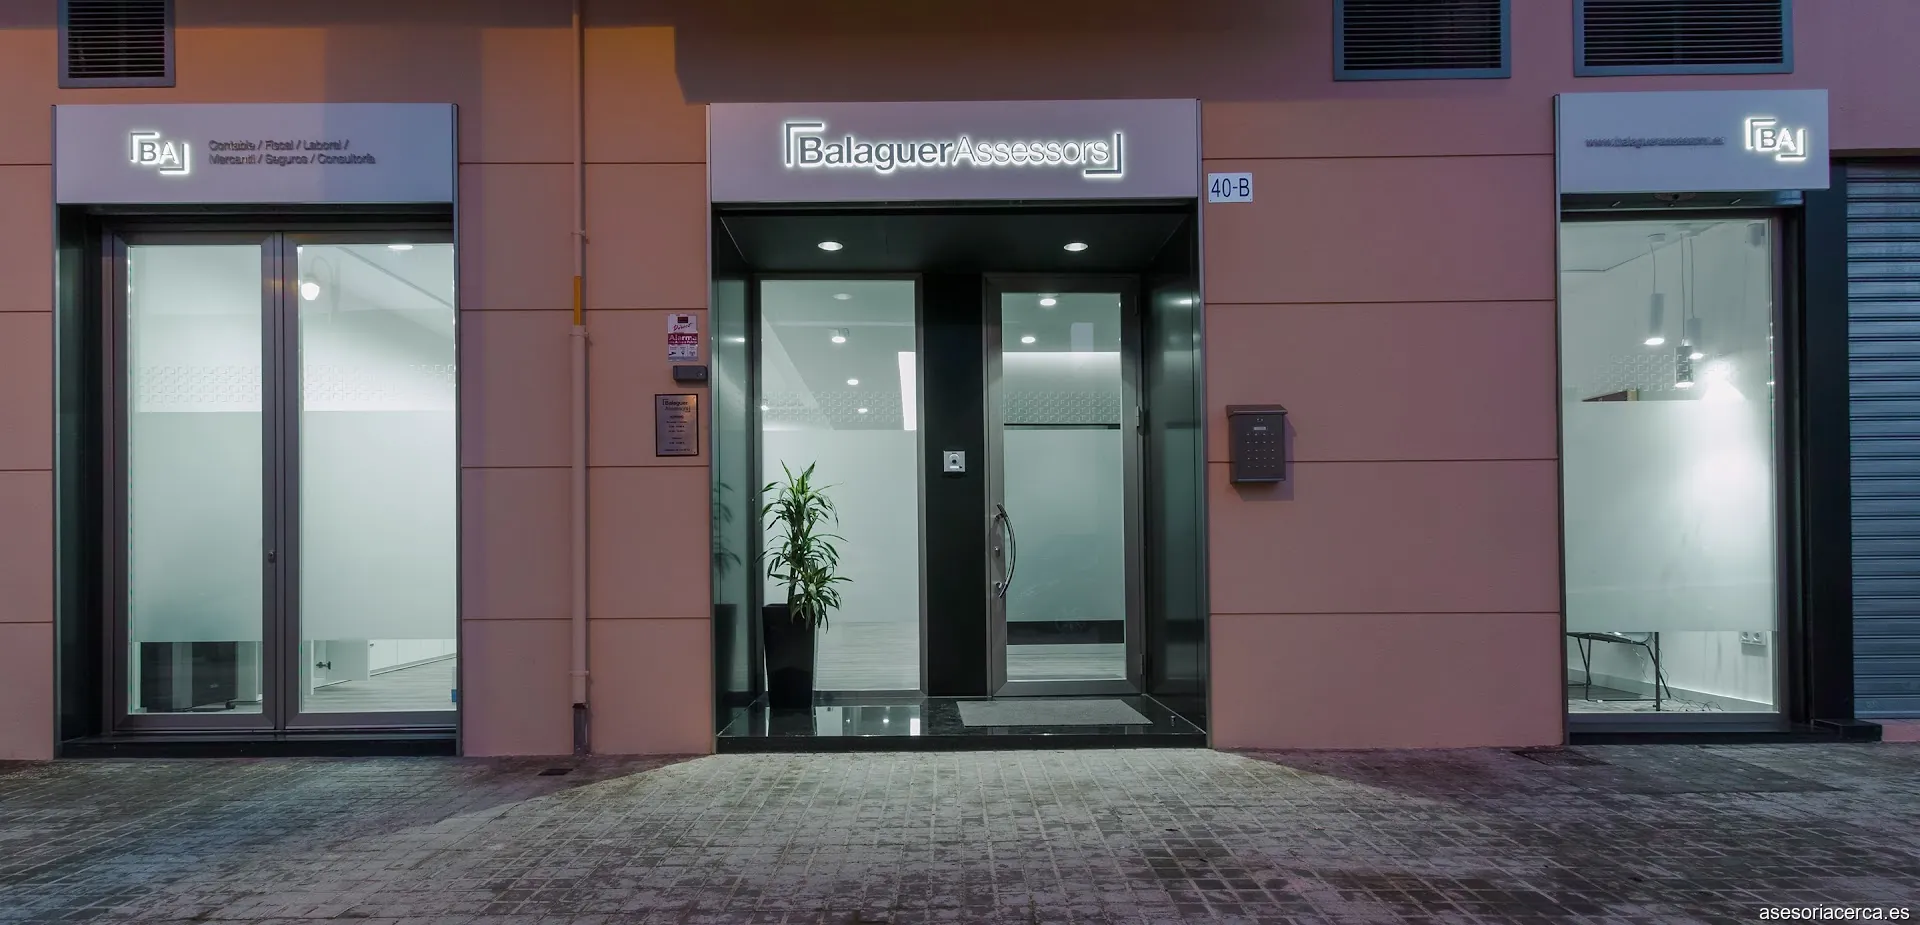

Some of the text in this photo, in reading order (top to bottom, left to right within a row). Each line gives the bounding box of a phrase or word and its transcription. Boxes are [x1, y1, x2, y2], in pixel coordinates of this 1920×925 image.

[209, 139, 256, 151] Contable
[265, 140, 294, 151] Fiscal
[303, 140, 342, 151] Laboral
[1758, 128, 1797, 151] BA
[140, 141, 179, 164] BA
[209, 154, 256, 165] Mercantil
[265, 154, 308, 167] Seguros
[1211, 178, 1250, 198] 40-B
